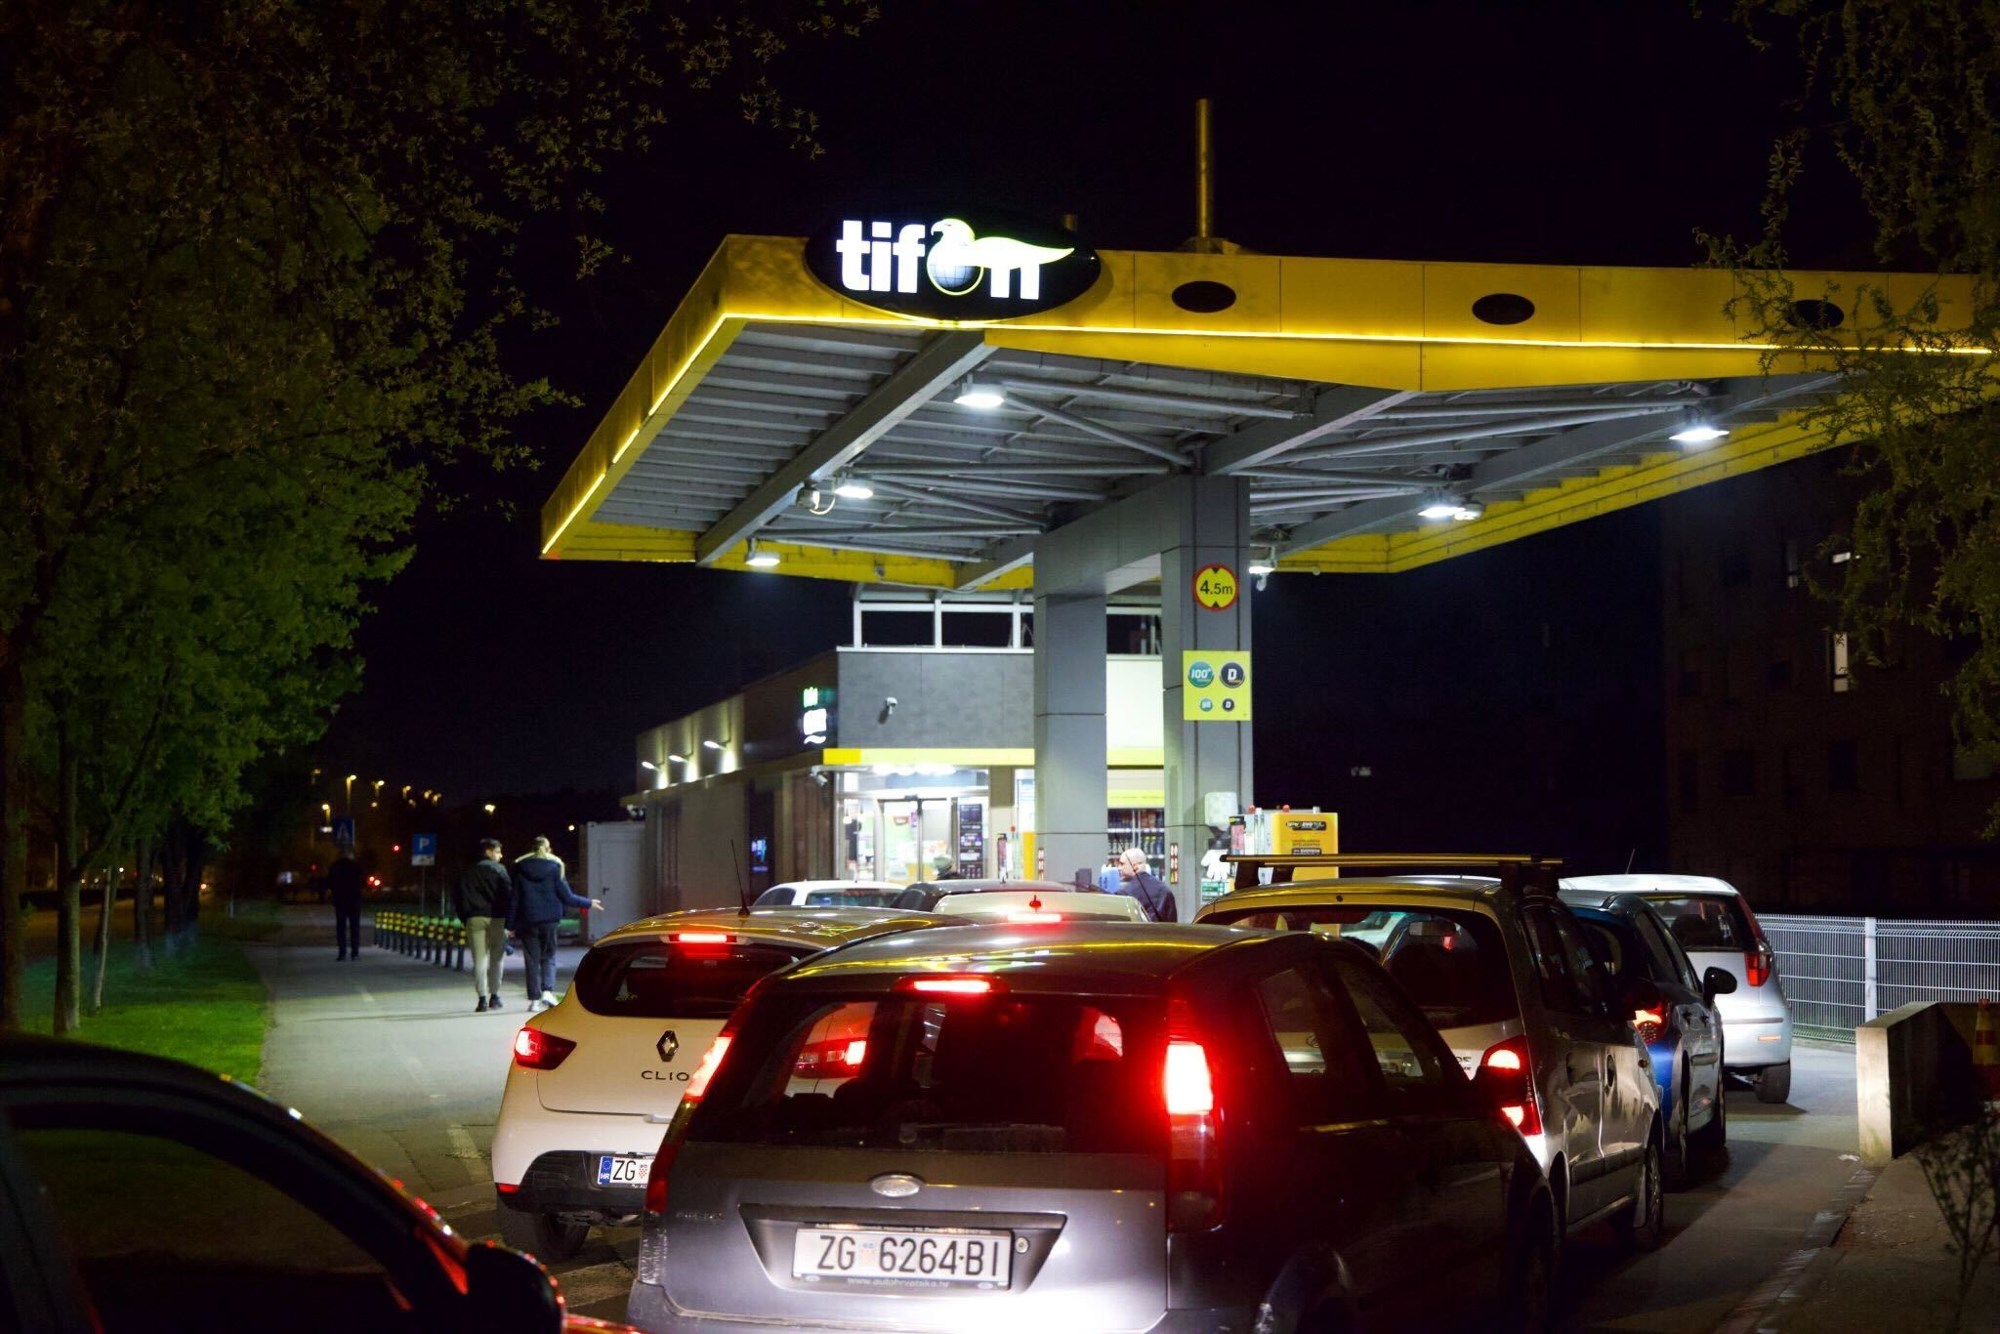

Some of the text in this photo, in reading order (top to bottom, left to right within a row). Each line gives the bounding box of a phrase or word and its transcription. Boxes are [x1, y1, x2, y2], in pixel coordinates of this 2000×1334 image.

[836, 217, 1074, 300] tifon
[1199, 580, 1233, 595] 4.5m
[1227, 669, 1238, 681] D
[419, 838, 430, 851] P
[641, 1070, 690, 1081] CLIO
[613, 1160, 637, 1181] ZG
[817, 1235, 855, 1270] ZG
